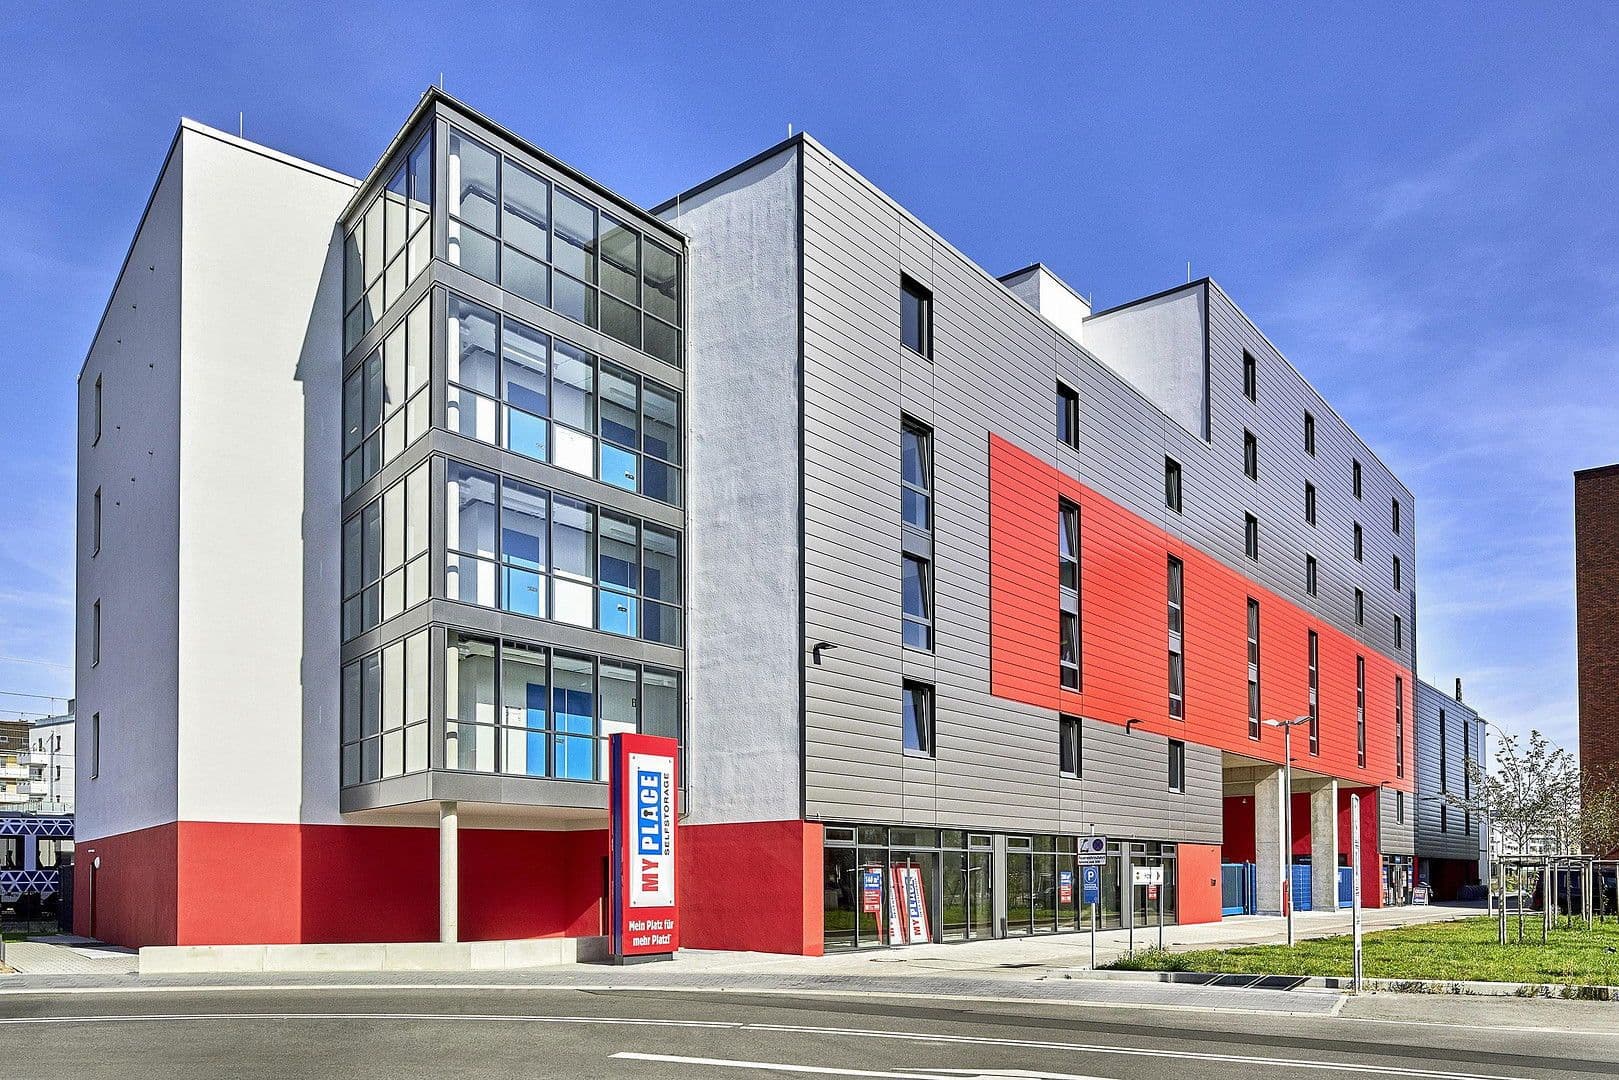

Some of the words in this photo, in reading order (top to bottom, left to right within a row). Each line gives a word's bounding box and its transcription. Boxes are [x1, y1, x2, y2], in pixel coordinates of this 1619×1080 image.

[640, 775, 660, 851] PLACE
[642, 858, 659, 892] MY
[1088, 871, 1095, 881] P
[629, 920, 646, 931] Mein
[646, 919, 663, 930] Platz
[664, 919, 674, 930] für
[632, 935, 651, 947] mehr
